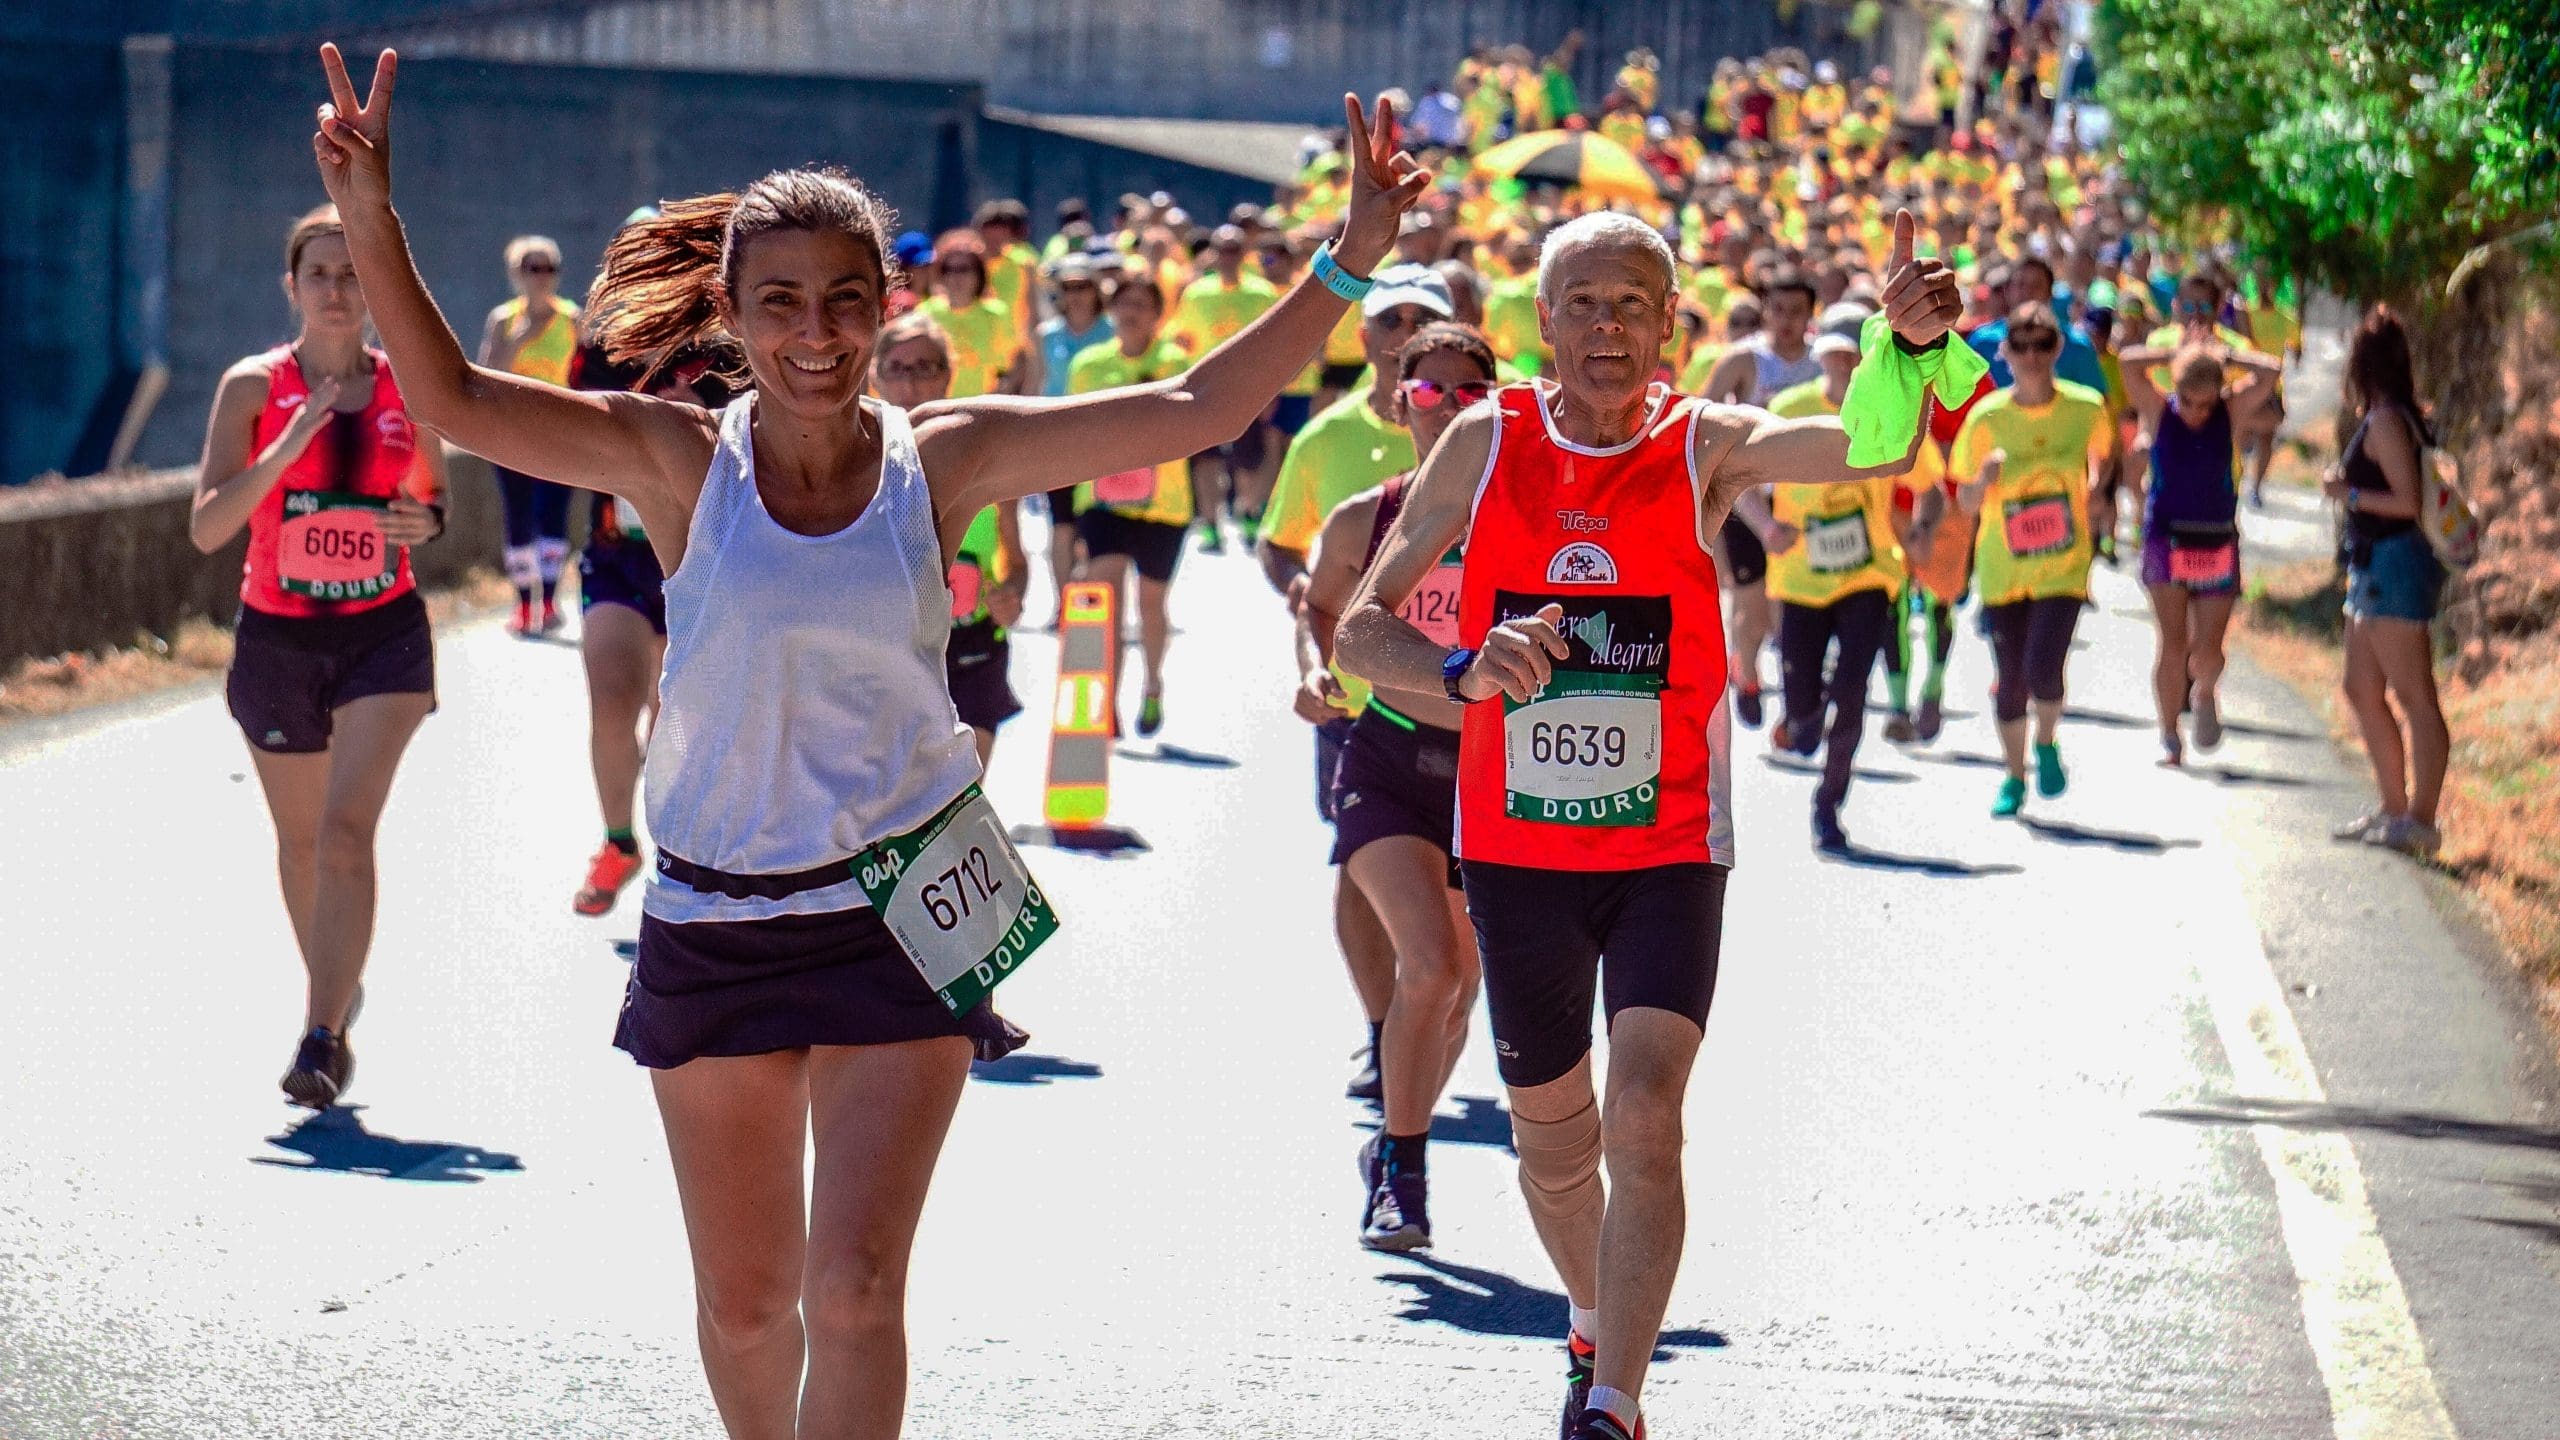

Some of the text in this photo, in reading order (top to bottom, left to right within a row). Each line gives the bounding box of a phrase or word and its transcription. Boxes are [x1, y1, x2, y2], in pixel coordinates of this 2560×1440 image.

[305, 527, 376, 560] 6056
[310, 571, 396, 599] DOURO
[1590, 623, 1663, 674] alegria
[1566, 689, 1580, 697] MAIS
[1598, 689, 1625, 697] CORRIDA
[1635, 690, 1655, 698] MUNDO
[1531, 721, 1627, 768] 6639
[1542, 783, 1655, 821] DOURO
[920, 846, 1003, 932] 6712
[973, 884, 1042, 988] DOURO
